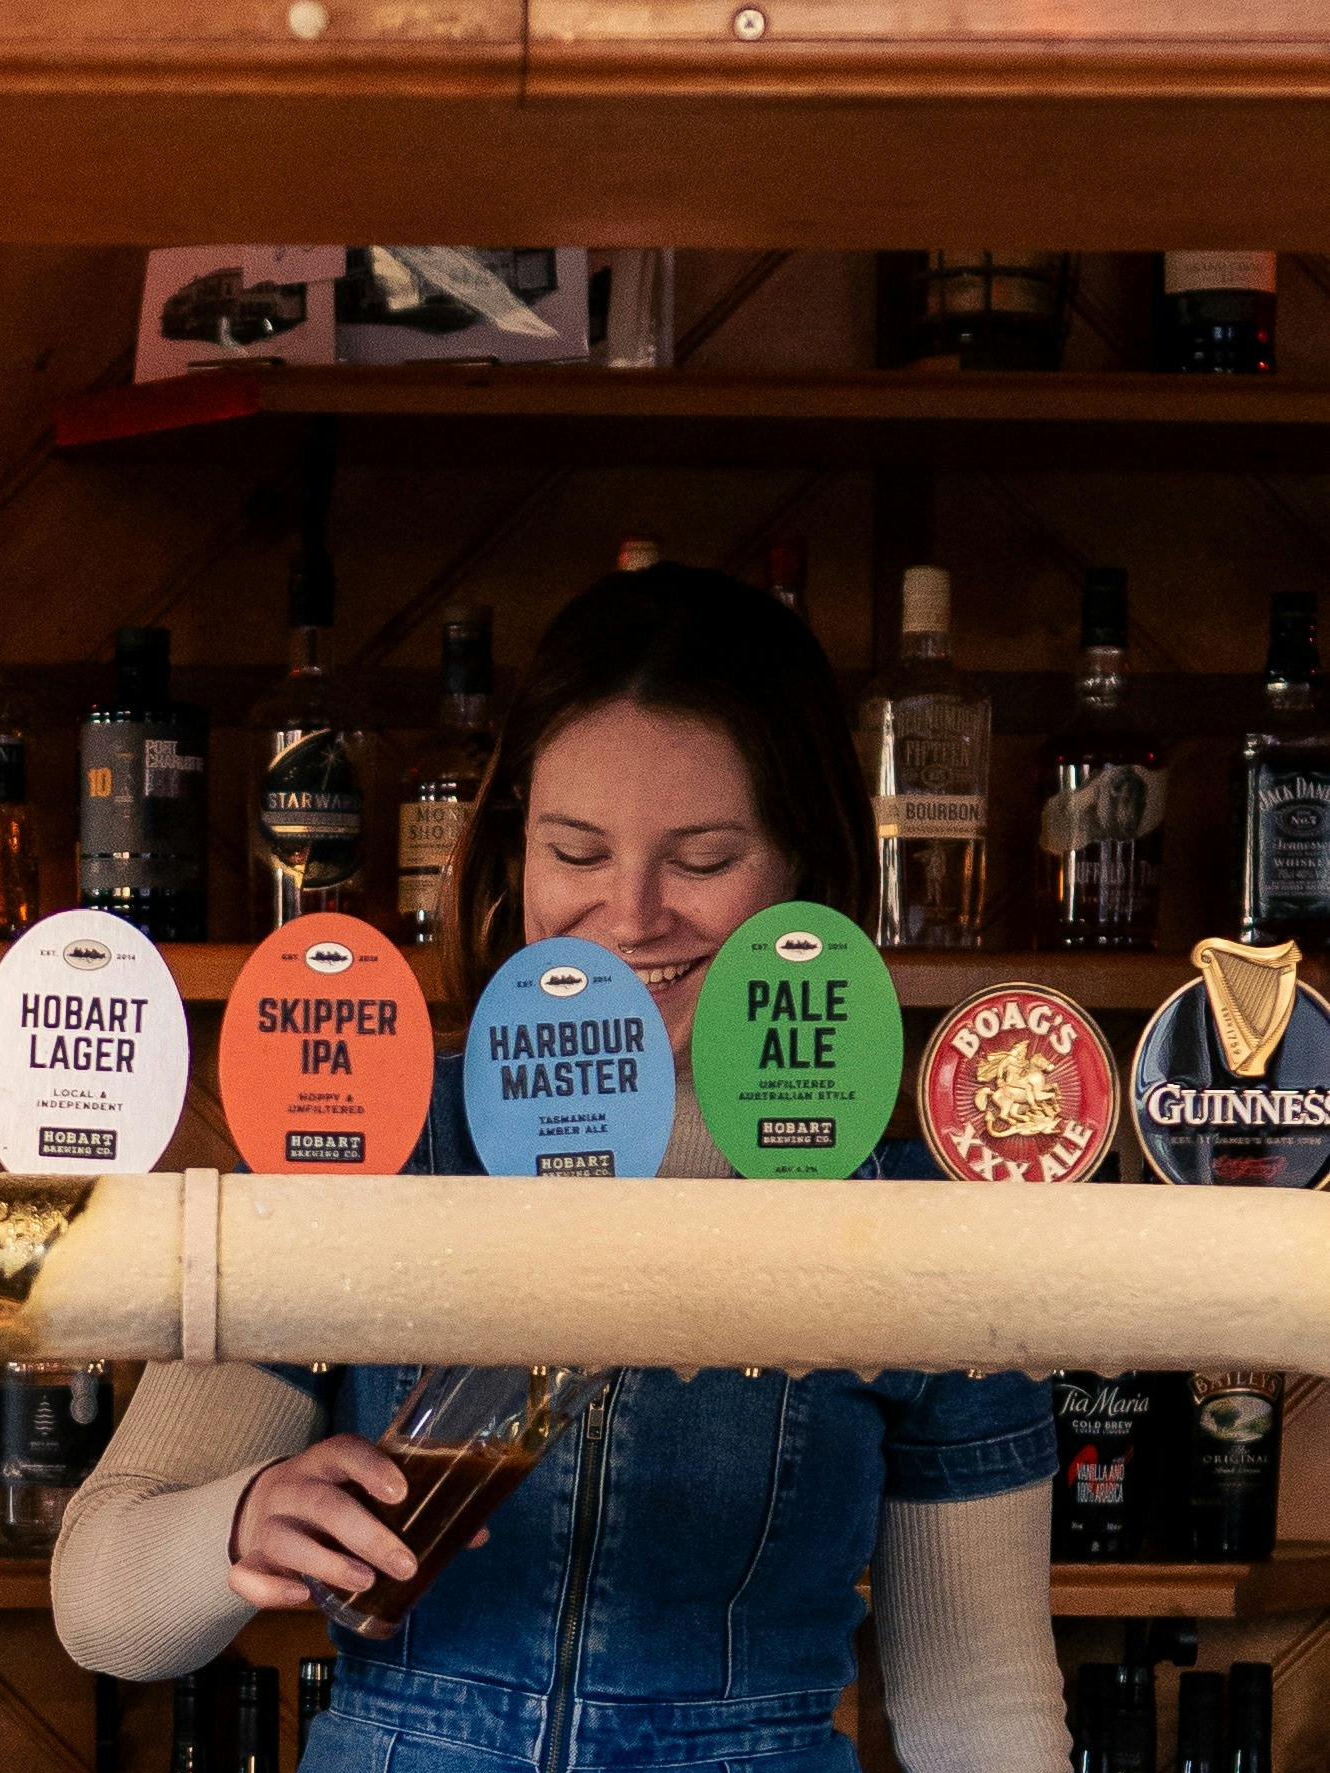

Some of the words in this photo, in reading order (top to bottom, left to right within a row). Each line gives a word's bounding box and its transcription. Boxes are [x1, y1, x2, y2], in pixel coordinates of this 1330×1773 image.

[87, 767, 113, 798] 10
[268, 792, 360, 810] STARWA
[906, 802, 980, 821] BOURBON
[747, 980, 849, 1022] PALE
[21, 993, 149, 1033] HOBART
[258, 997, 398, 1036] SKIPPER
[950, 1001, 1079, 1060] BOAG'S
[489, 1017, 645, 1061] HARBOUR
[29, 1034, 136, 1074] LAGER
[758, 1027, 836, 1070] ALE
[301, 1039, 353, 1075] IPA
[501, 1057, 639, 1101] MASTER
[758, 1079, 836, 1090] UNFILTERED
[53, 1088, 95, 1099] LOCAL
[298, 1093, 341, 1102] HOPPY
[738, 1091, 813, 1101] AUSTRALIAN
[817, 1090, 856, 1101] STYLE
[36, 1100, 124, 1112] INDEPENDENT
[287, 1104, 366, 1115] UNFILTERED
[1147, 1083, 1330, 1126] GUINNES
[538, 1113, 607, 1125] TASMANIAN
[538, 1126, 581, 1137] AMBER
[584, 1124, 608, 1134] ALE
[762, 1121, 833, 1134] HOBART
[43, 1130, 114, 1146] HOBART
[290, 1135, 362, 1149] HOBART
[762, 1136, 812, 1145] BREWING
[43, 1145, 93, 1156] BREWING
[290, 1149, 340, 1158] BREWING
[1039, 1119, 1094, 1182] ALE
[541, 1155, 611, 1170] HOBART
[1055, 1384, 1092, 1418] Tia
[1086, 1386, 1150, 1418] Maria
[1071, 1419, 1102, 1430] COLD
[1104, 1420, 1134, 1430] BREW
[1201, 1454, 1270, 1465] ORIGINAL
